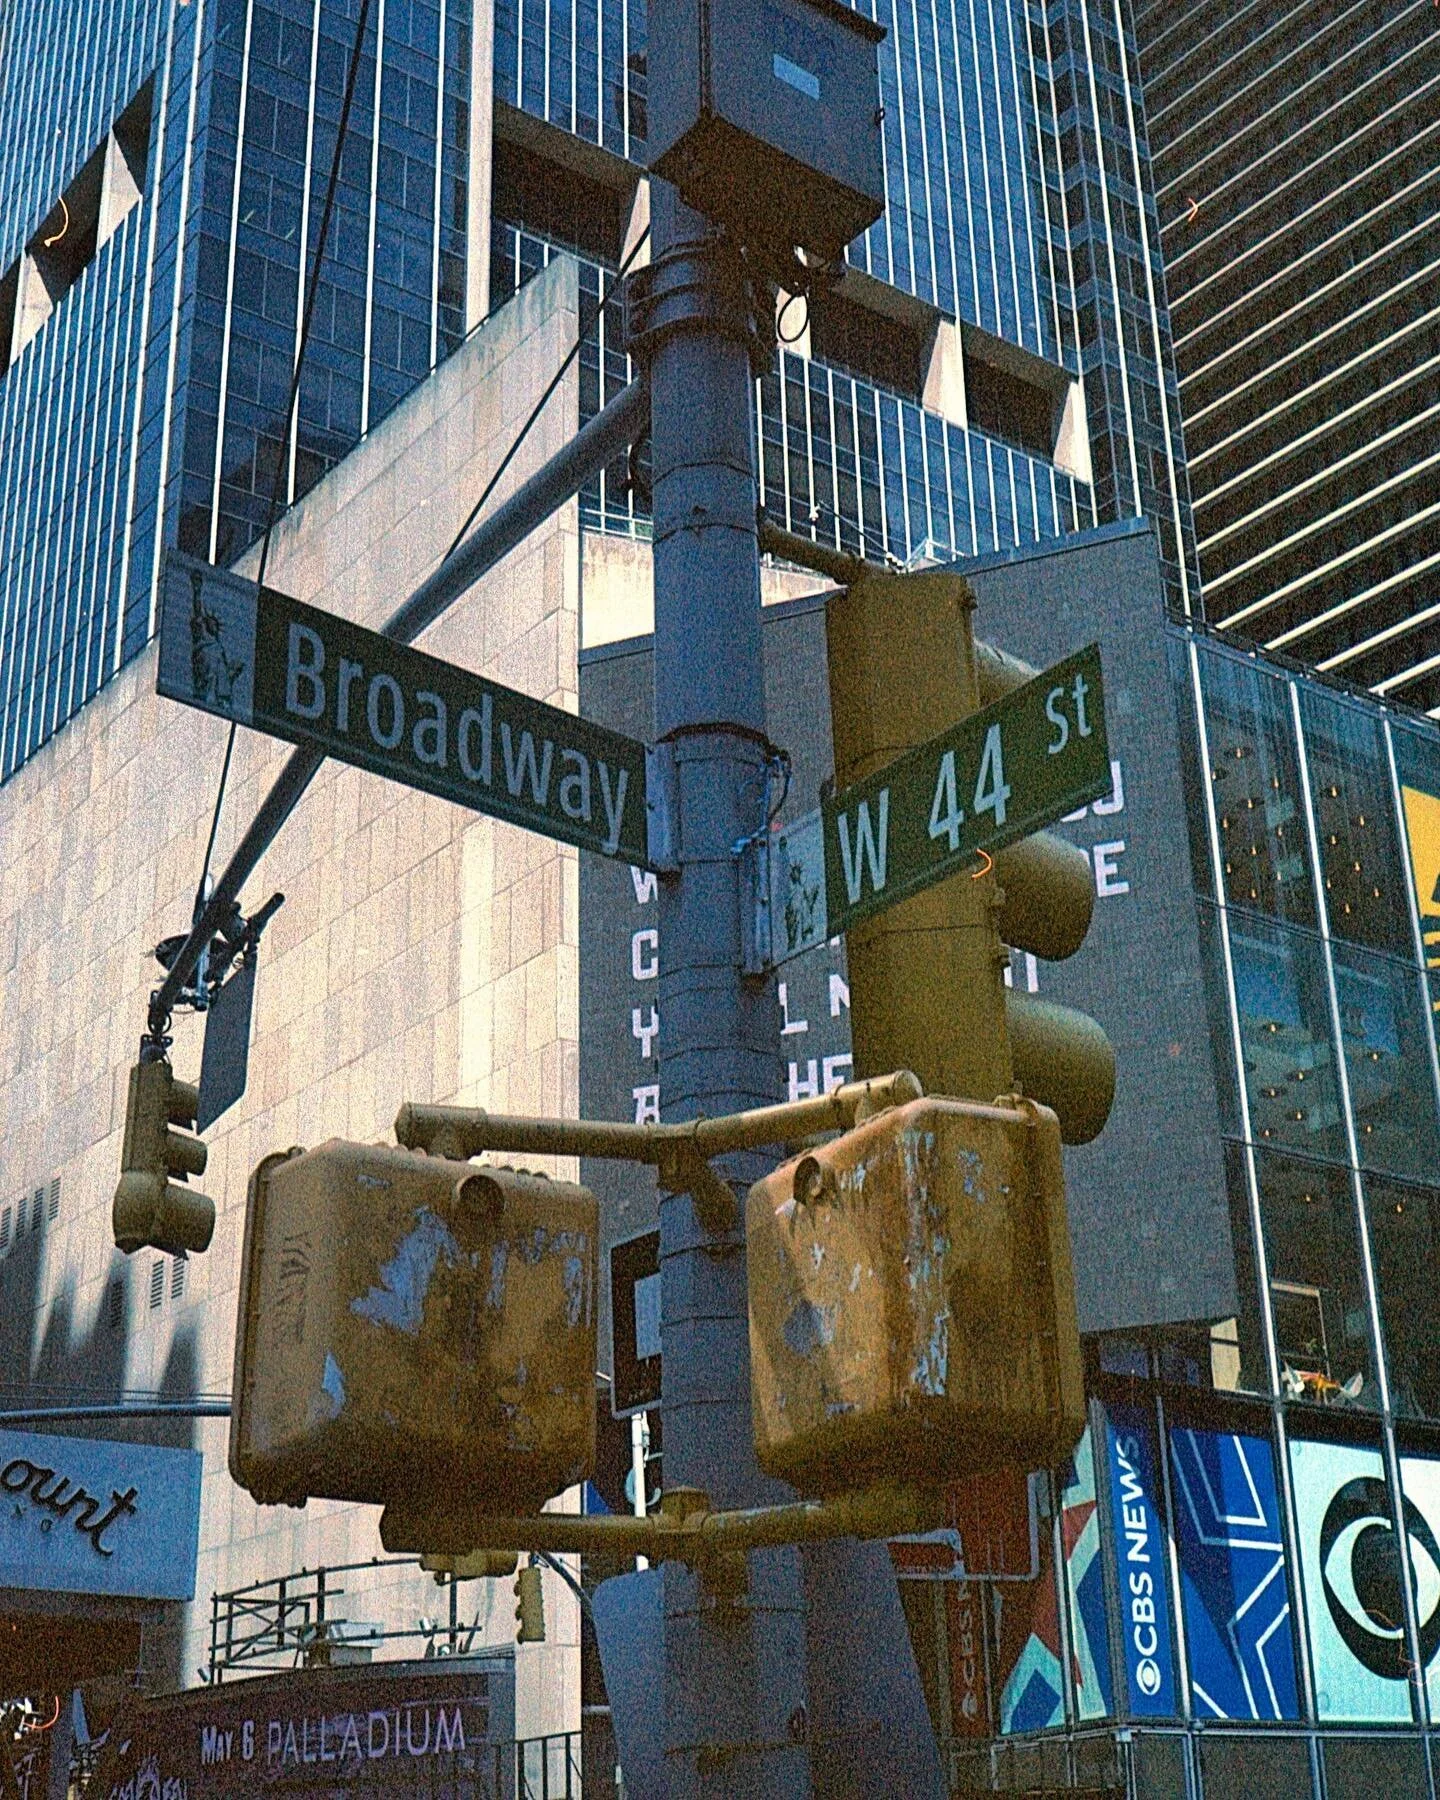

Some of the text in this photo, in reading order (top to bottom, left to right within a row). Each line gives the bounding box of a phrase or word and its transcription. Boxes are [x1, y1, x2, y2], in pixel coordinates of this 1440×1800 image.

[286, 623, 628, 854] Broadway
[837, 787, 889, 904] W
[928, 723, 1011, 850] 44
[1045, 673, 1092, 754] St
[0, 1459, 138, 1557] ount
[1115, 1435, 1158, 1658] CBS NEWS
[242, 1719, 255, 1761] 6
[267, 1707, 466, 1766] PALLADIUM
